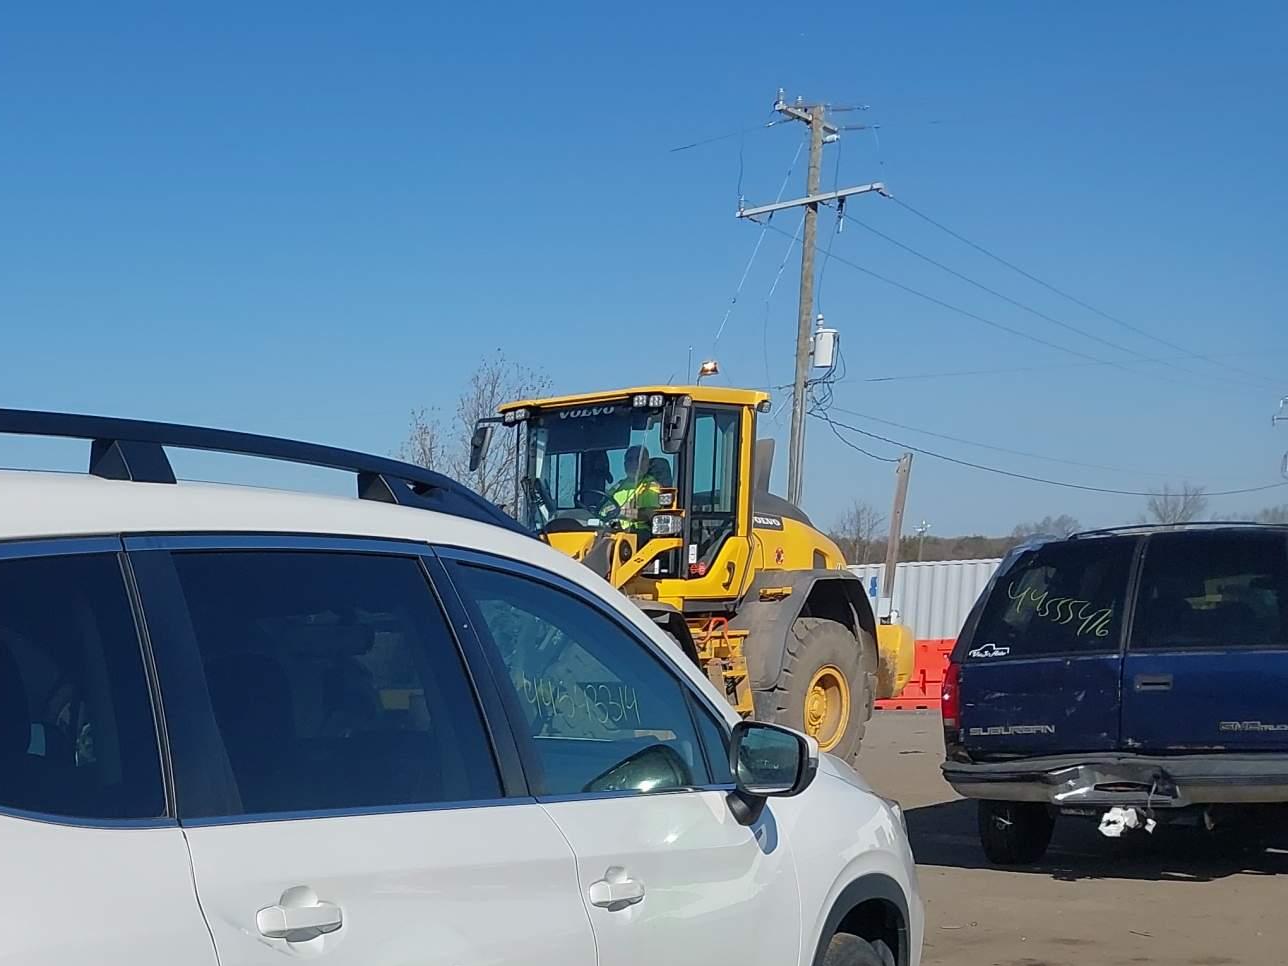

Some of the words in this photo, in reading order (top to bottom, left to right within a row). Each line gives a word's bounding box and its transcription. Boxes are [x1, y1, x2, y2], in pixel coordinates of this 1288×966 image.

[559, 406, 615, 420] VOLVO
[752, 516, 781, 526] OLVO
[969, 725, 1055, 736] SUBURBAN
